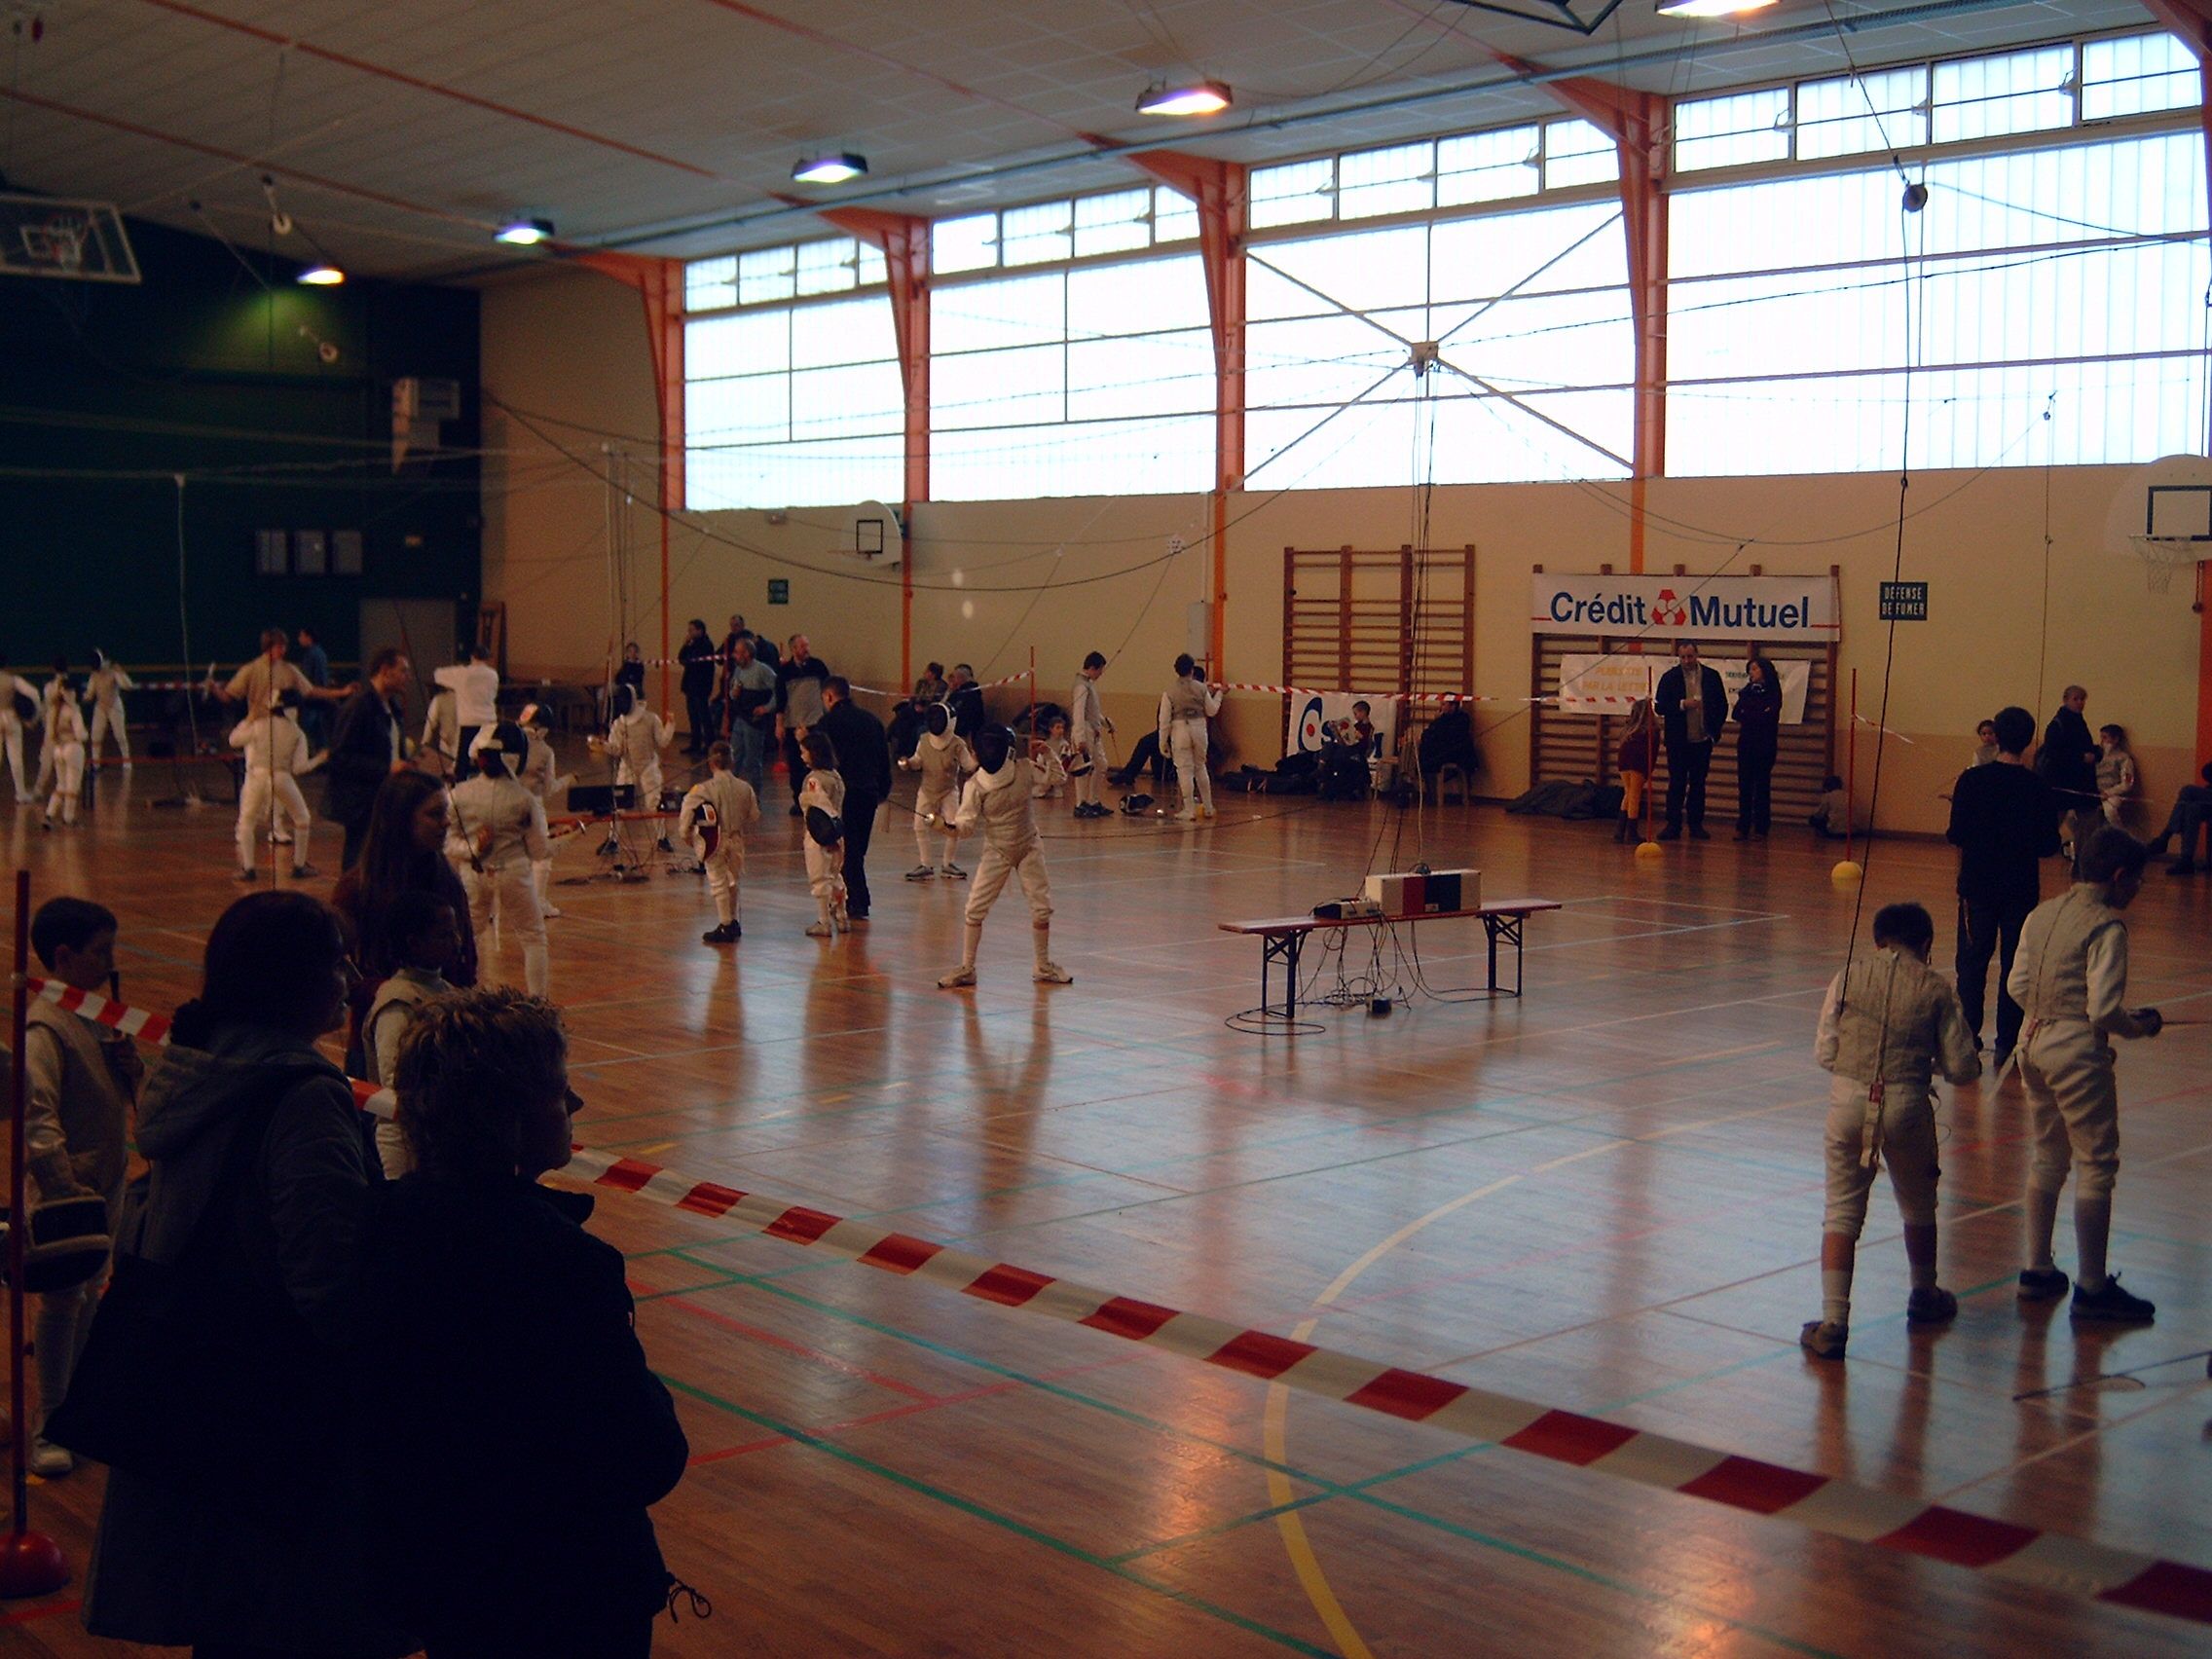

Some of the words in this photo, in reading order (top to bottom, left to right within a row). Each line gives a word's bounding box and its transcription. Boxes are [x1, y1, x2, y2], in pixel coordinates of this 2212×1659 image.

[1550, 591, 1647, 625] Crédit
[1689, 595, 1809, 629] Mutuel
[1896, 603, 1925, 615] FUMER
